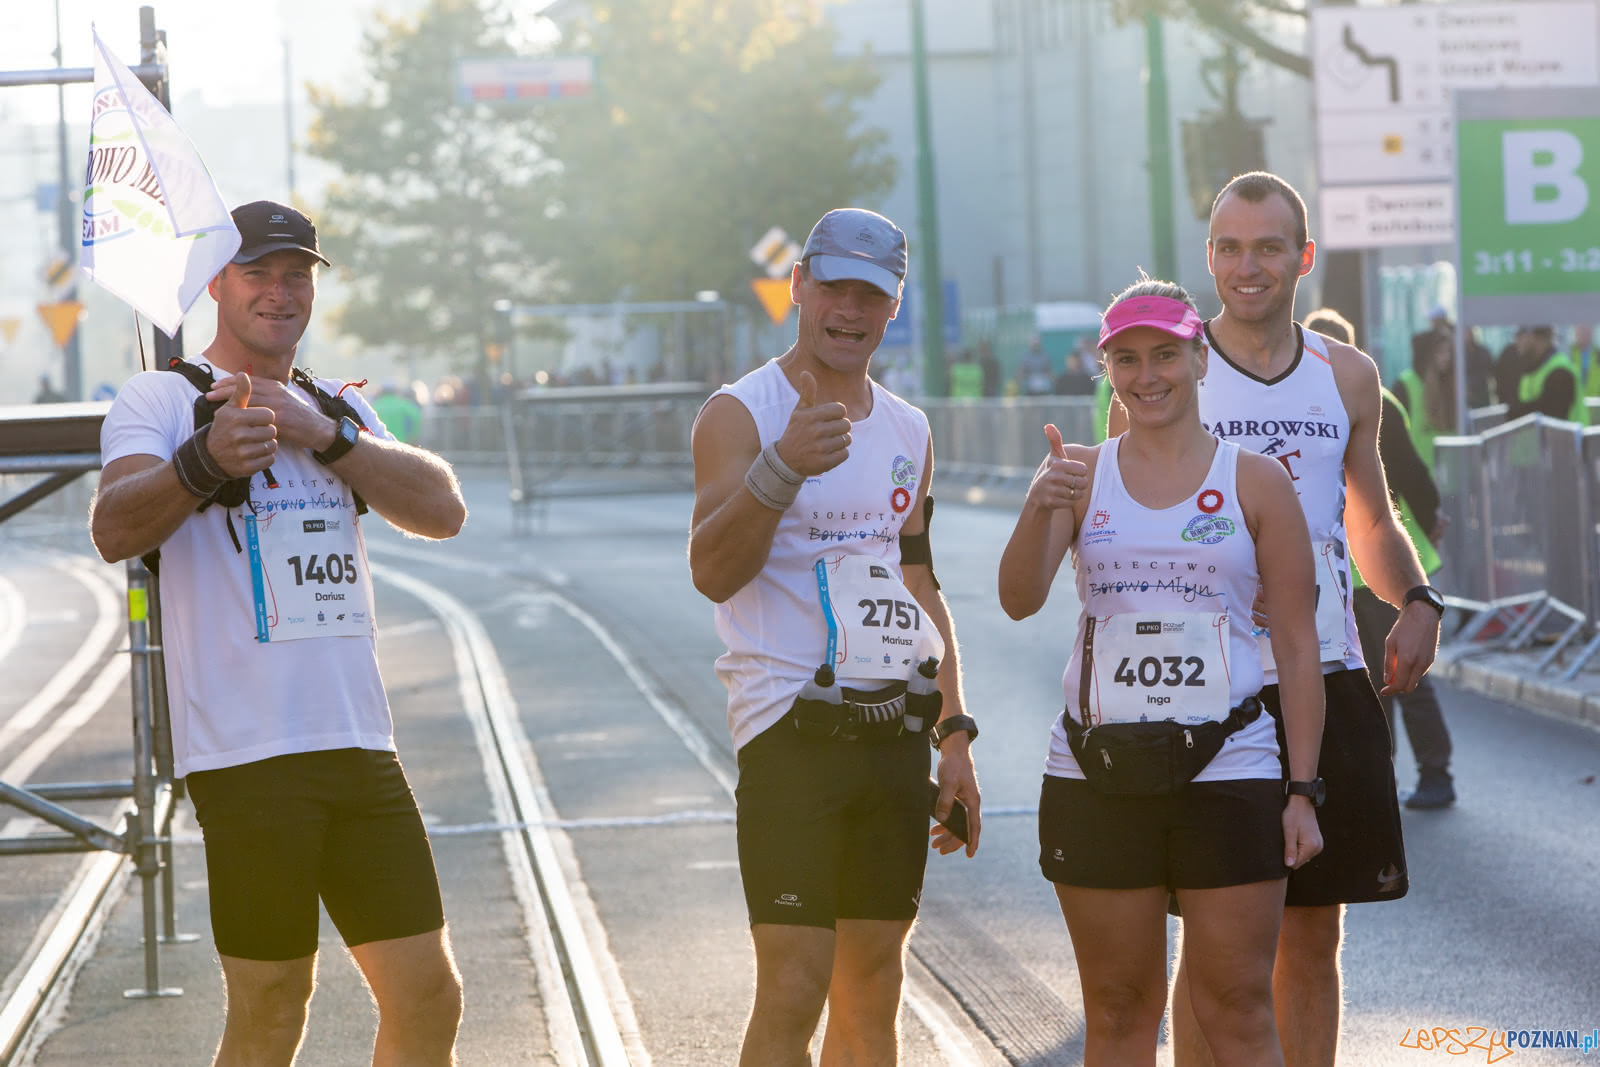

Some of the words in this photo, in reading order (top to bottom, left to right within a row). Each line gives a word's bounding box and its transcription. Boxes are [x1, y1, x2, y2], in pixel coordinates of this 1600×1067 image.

[1502, 129, 1589, 225] B
[1473, 250, 1533, 273] 3:11
[287, 553, 358, 586] 1405
[1087, 561, 1217, 575] SOŁECTWO
[315, 592, 346, 601] Dariusz
[1089, 579, 1150, 597] Borowo
[858, 599, 920, 631] 2757
[882, 635, 913, 646] Mariusz
[1114, 656, 1206, 687] 4032
[1147, 695, 1171, 706] Inga
